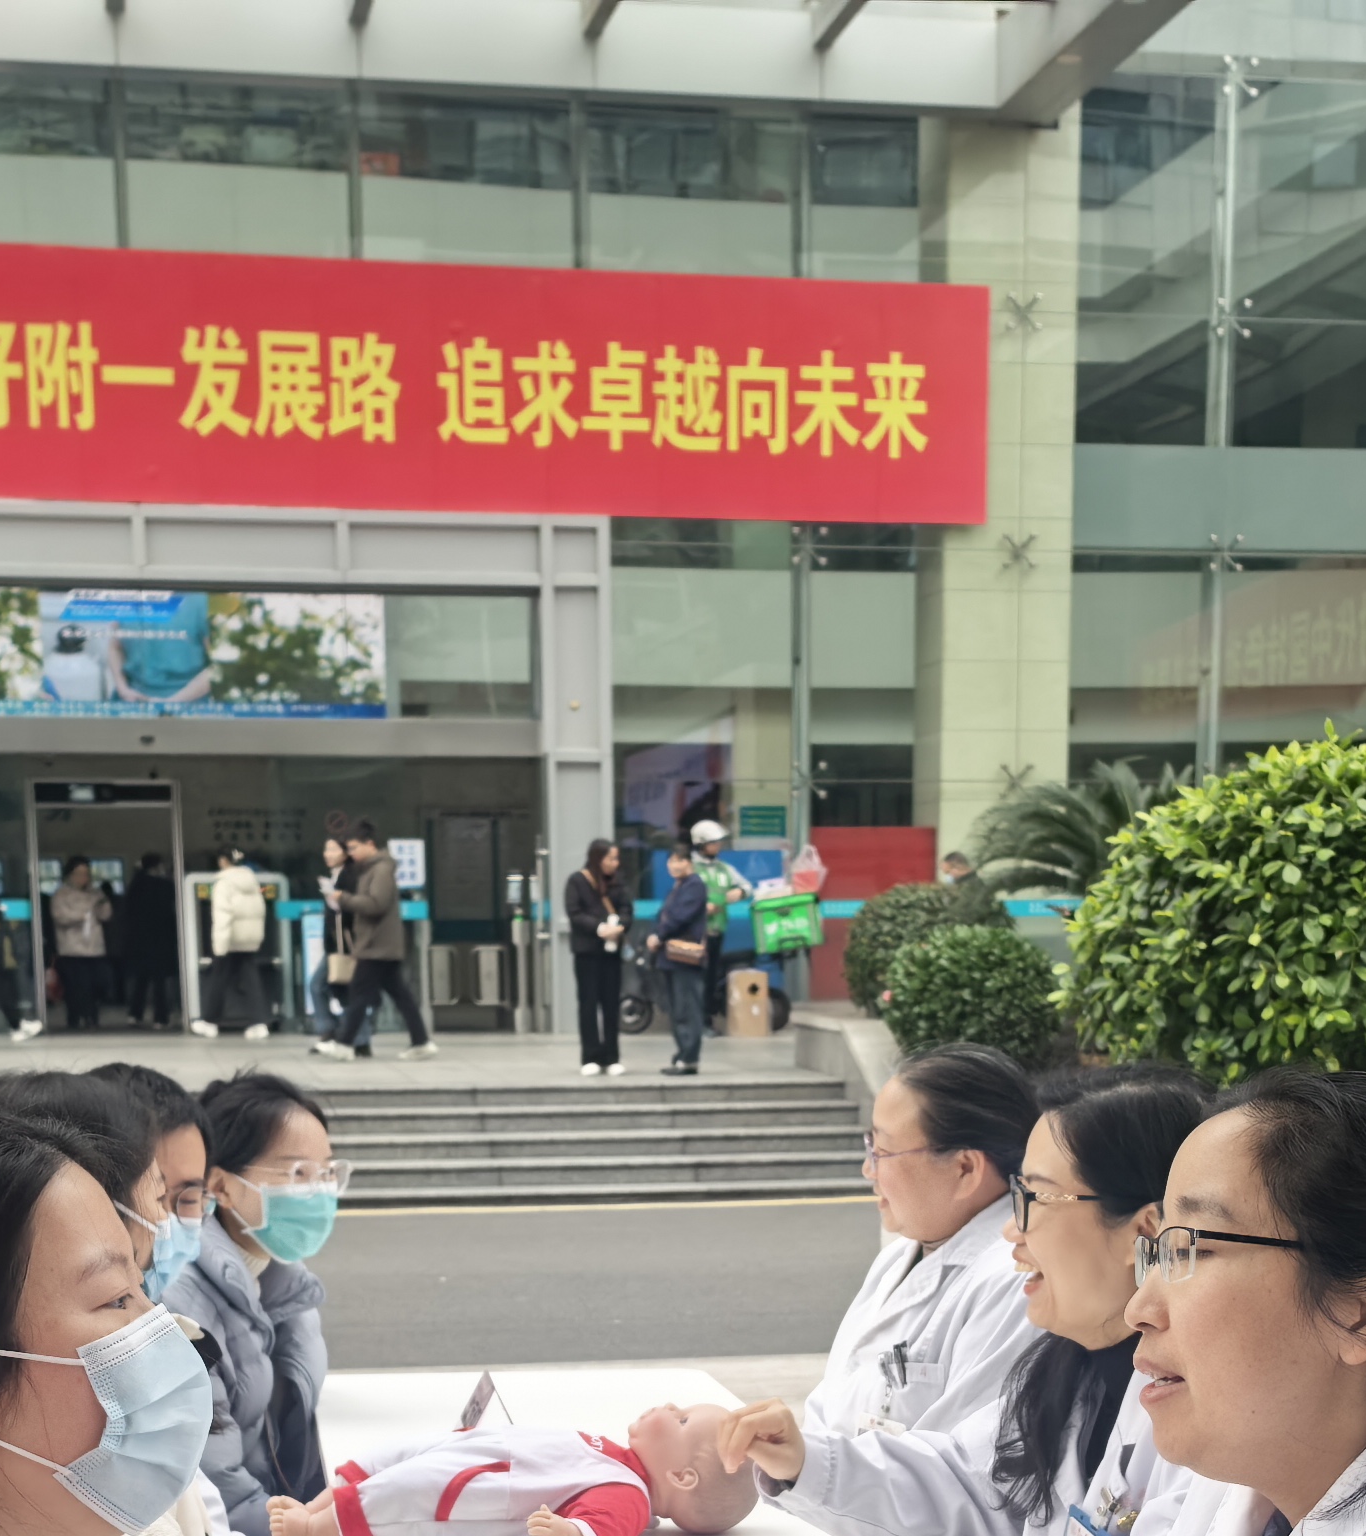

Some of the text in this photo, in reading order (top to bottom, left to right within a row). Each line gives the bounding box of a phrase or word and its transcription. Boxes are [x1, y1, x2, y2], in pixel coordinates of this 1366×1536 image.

[436, 336, 929, 458] 追求卓越向未来
